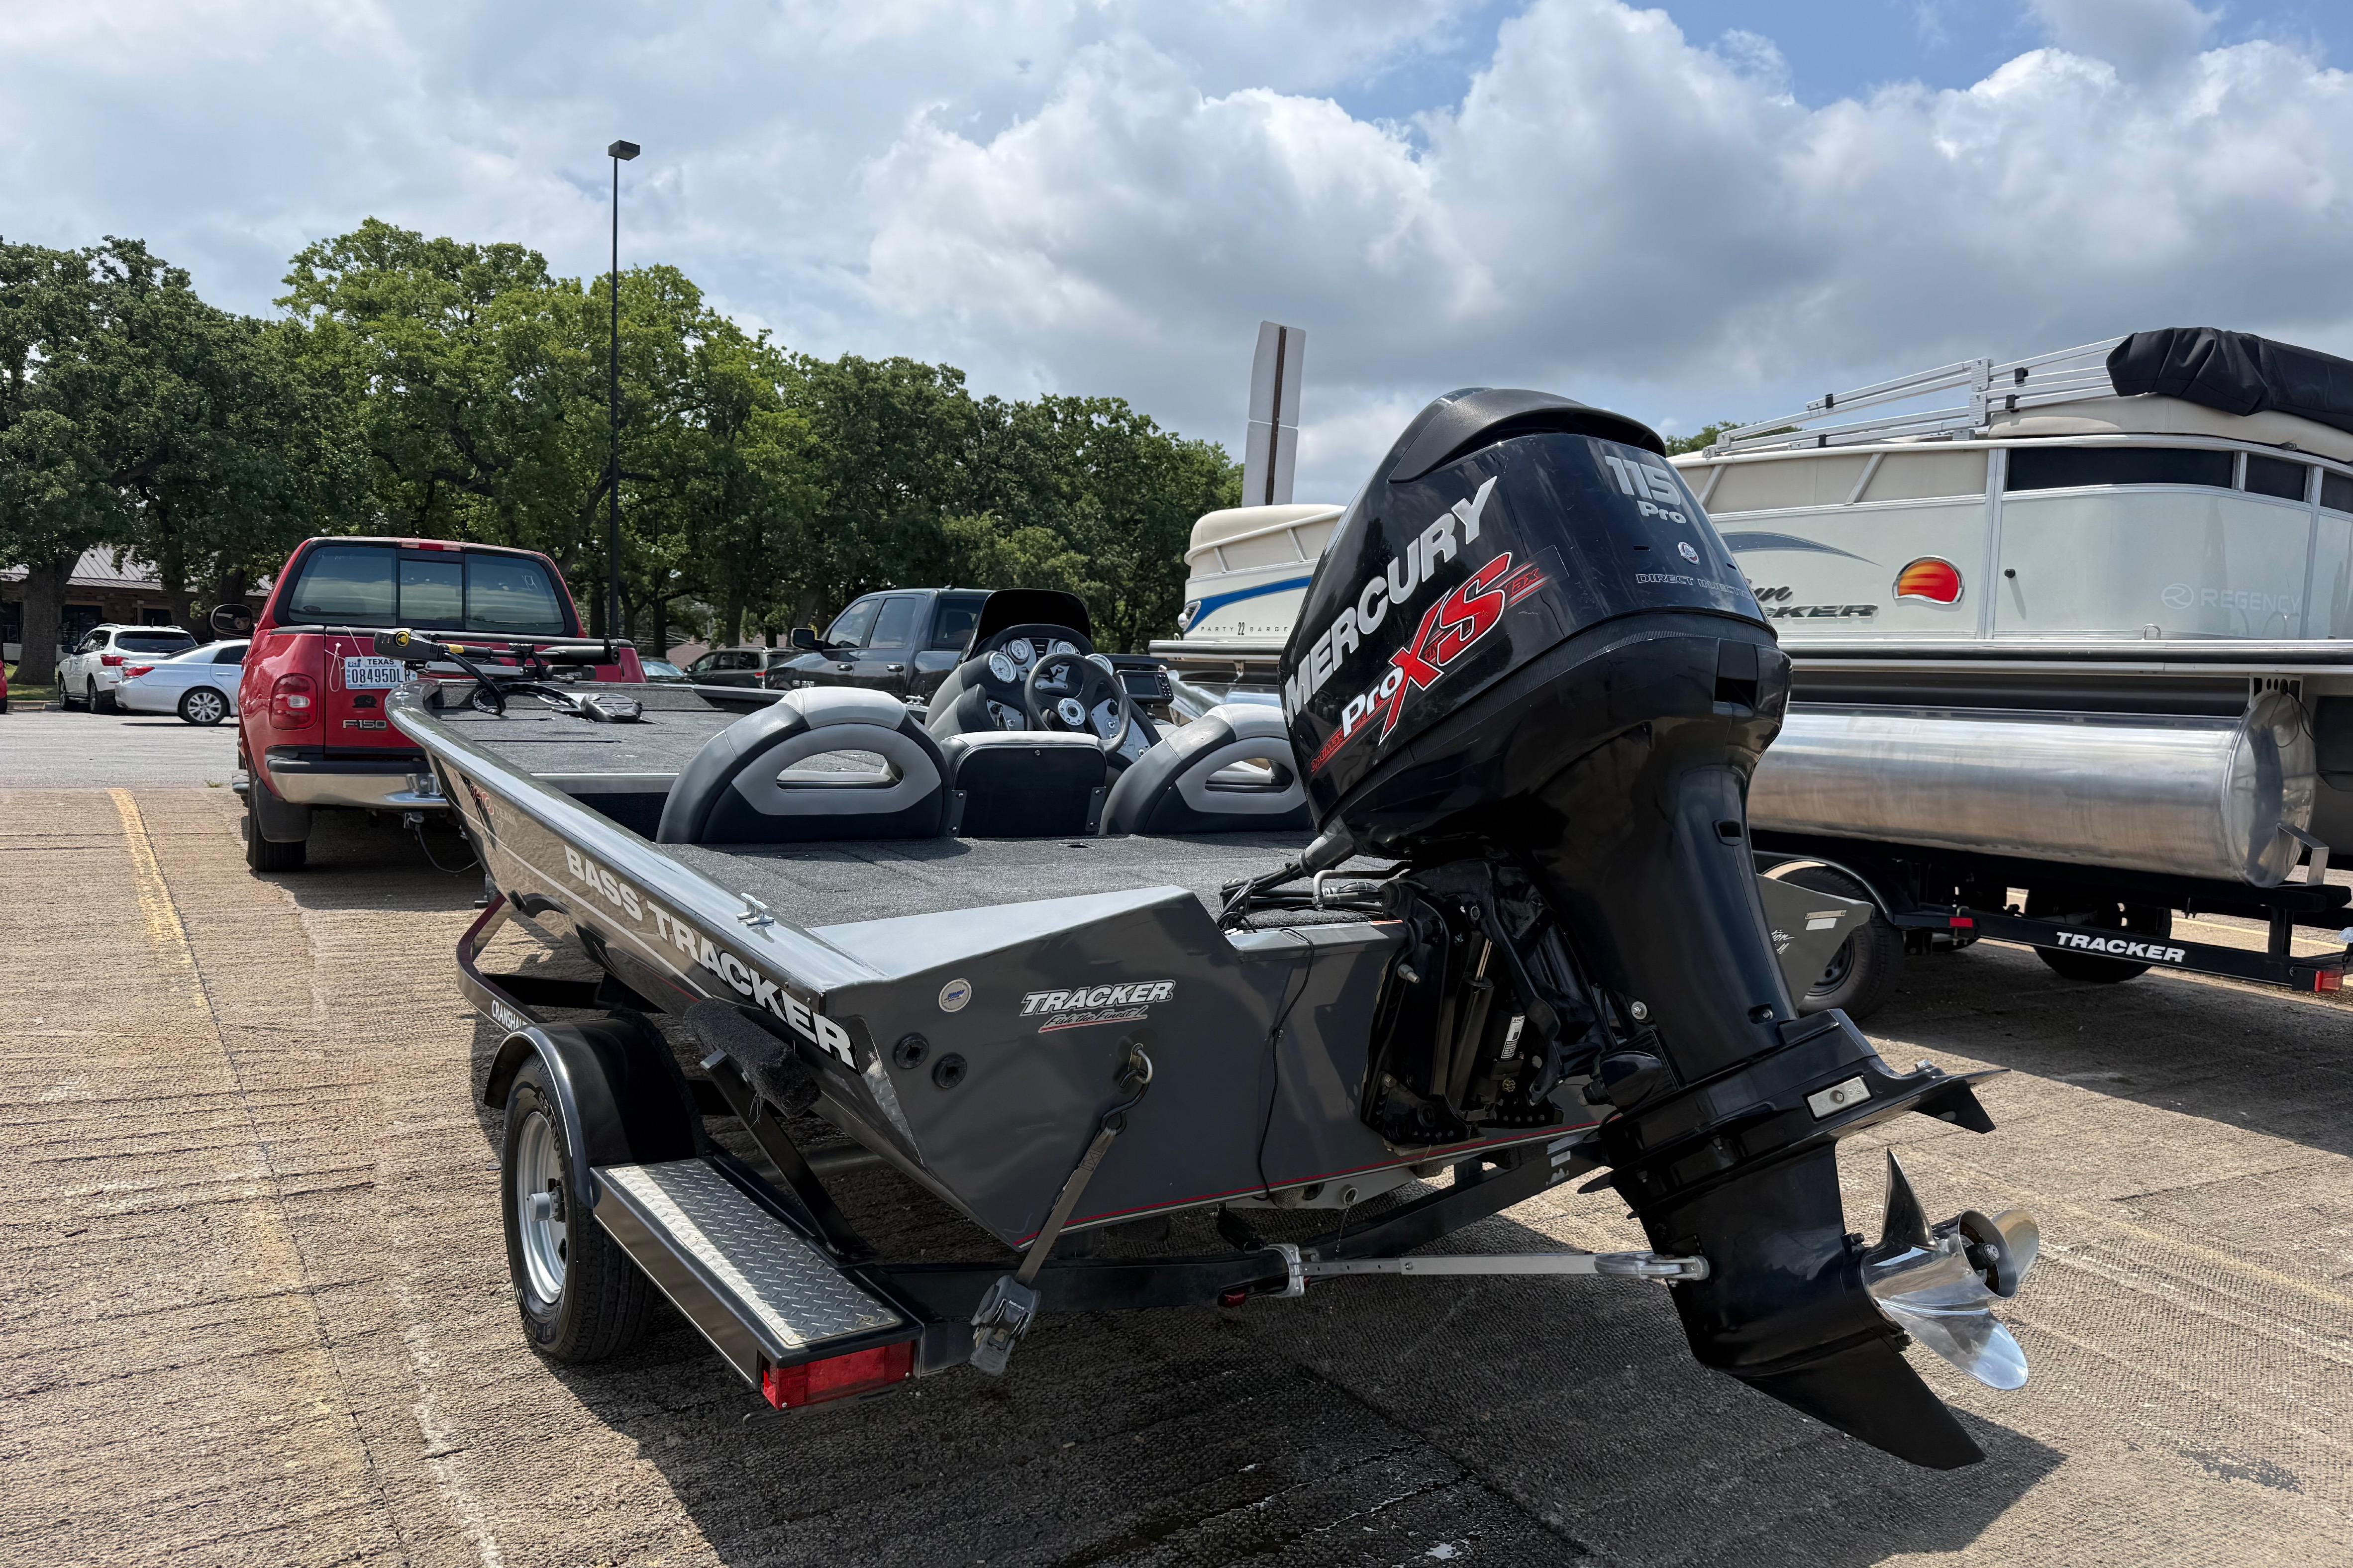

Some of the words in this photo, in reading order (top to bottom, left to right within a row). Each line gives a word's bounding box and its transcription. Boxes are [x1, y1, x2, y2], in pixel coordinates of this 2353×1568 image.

[1605, 455, 1681, 505] 115
[1637, 500, 1687, 524] Pro
[1636, 574, 1694, 586] DIRECT
[1284, 476, 1498, 727] MERCURY
[2201, 588, 2301, 613] REGENCY
[1237, 622, 1245, 636] 22
[351, 668, 410, 683] 08495DLR
[343, 719, 387, 730] F-150
[1311, 731, 1344, 772] OptiMax
[563, 845, 643, 921] BASS
[646, 899, 857, 1070] TRACKER
[2056, 932, 2185, 963] TRACKER
[1045, 1015, 1073, 1026] Fish
[1075, 1013, 1094, 1023] the
